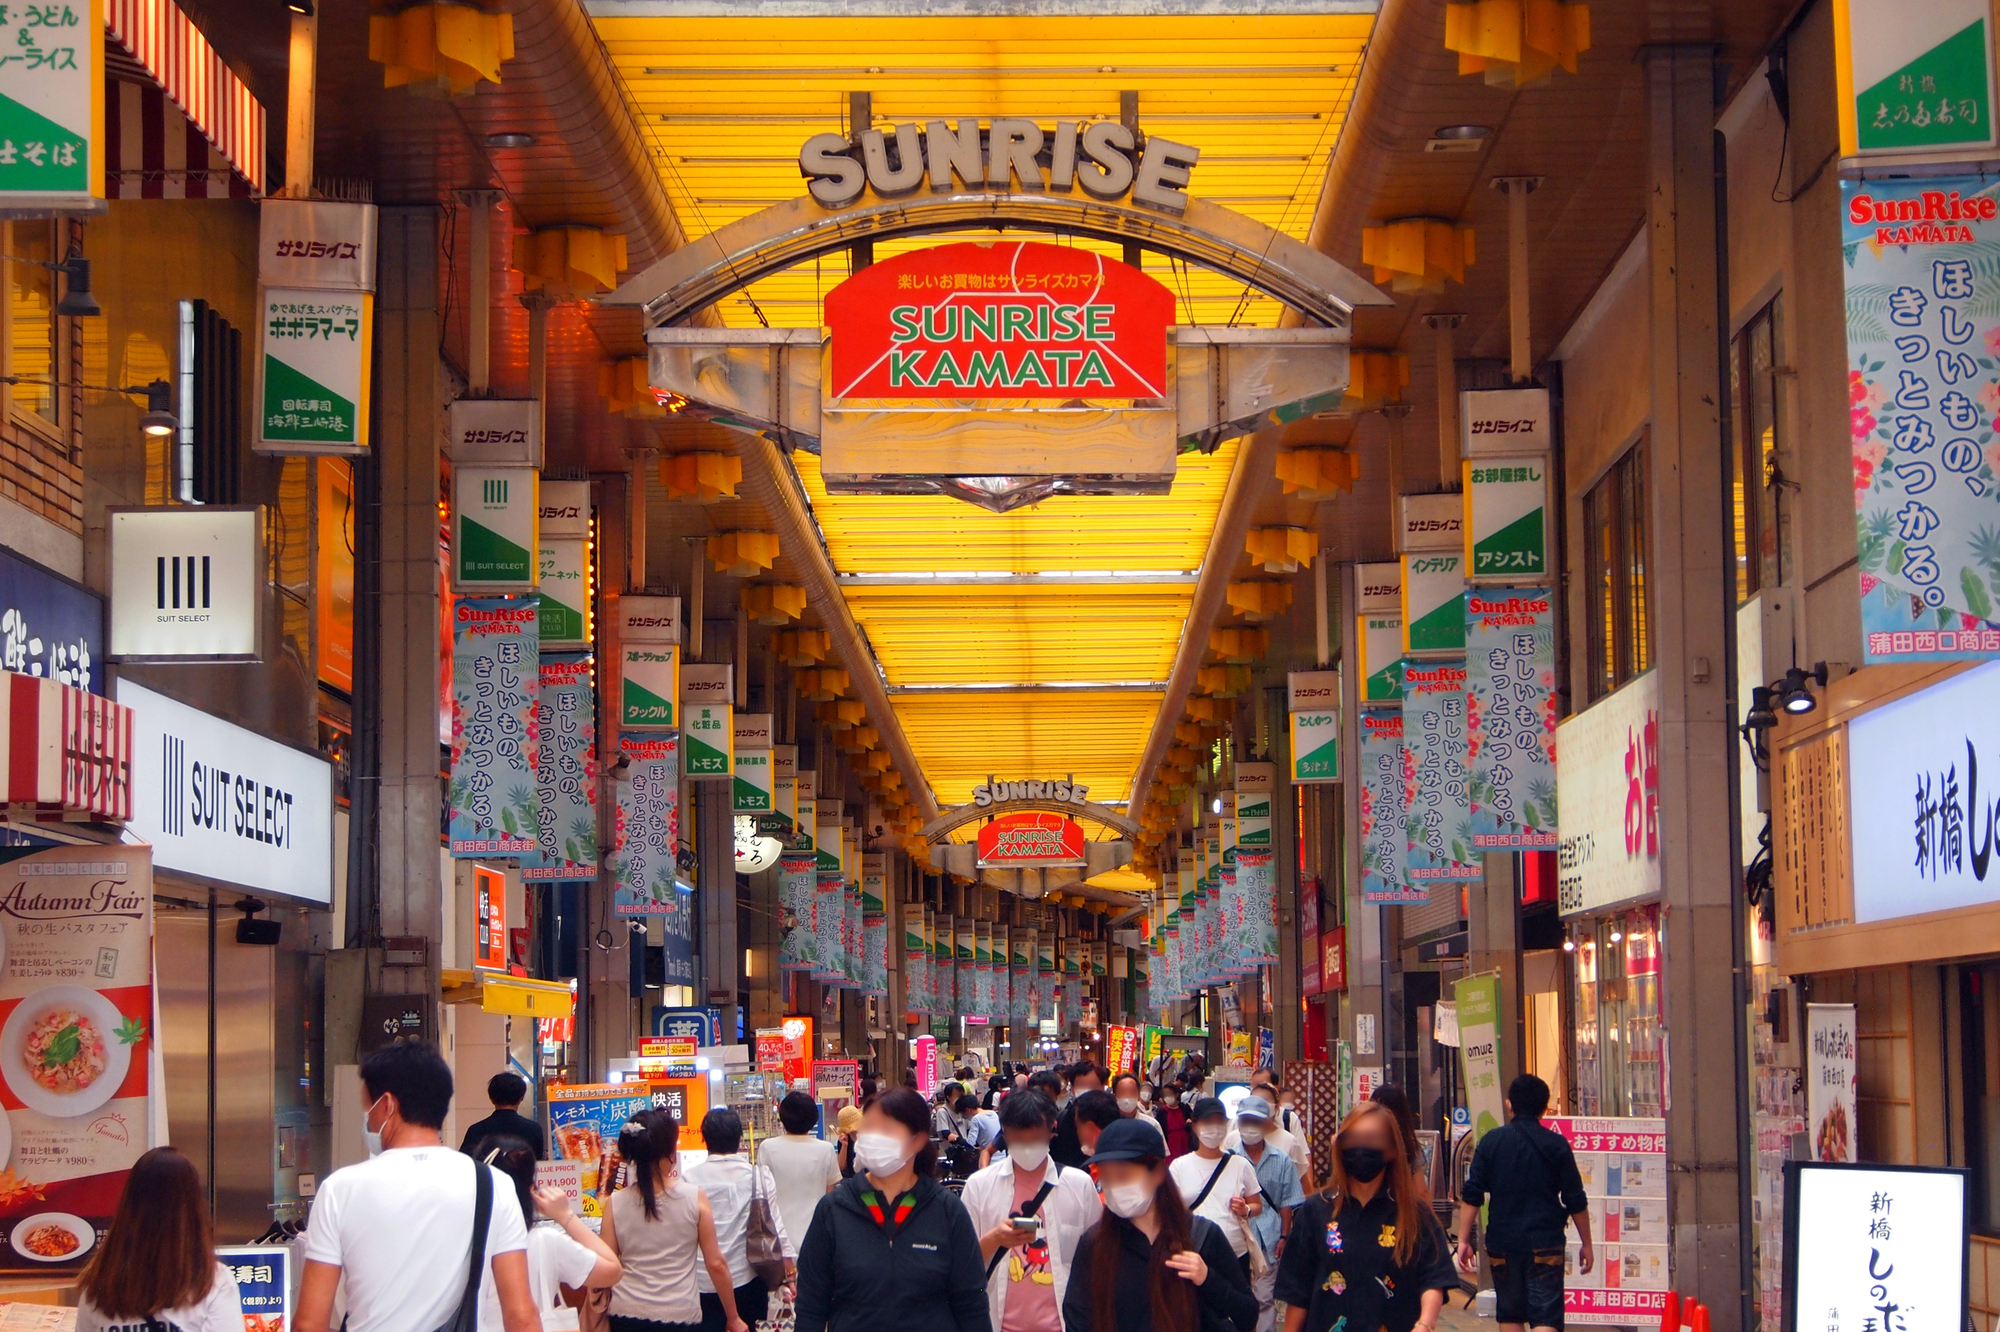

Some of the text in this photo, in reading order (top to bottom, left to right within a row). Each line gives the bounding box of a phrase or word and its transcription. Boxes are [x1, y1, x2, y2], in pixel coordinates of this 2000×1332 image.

[18, 28, 35, 46] &
[800, 118, 1200, 216] SUNRISE
[1849, 191, 1998, 225] SunRise
[1875, 225, 1976, 246] KAMATA
[276, 240, 361, 260] サンライズ
[898, 274, 1106, 289] 楽しいお買物はサンライズカマタ
[269, 303, 359, 316] ゆであげ生スパゲティ
[269, 318, 358, 341] ポポラマーマ
[890, 304, 1115, 343] SUNRISE
[890, 350, 1115, 387] KAMATA
[1932, 259, 1986, 497] ほしいもの、
[282, 400, 331, 413] 回転寿司
[268, 416, 349, 432] 海鮮三崎港
[1471, 420, 1537, 434] サンライズ
[463, 430, 528, 444] サンライズ
[1888, 286, 1945, 608] きっとみつかる。
[1471, 468, 1541, 483] お部屋探し
[1408, 519, 1462, 532] サンライズ
[477, 562, 525, 570] SUIT SELECT
[1412, 557, 1459, 574] インテリア
[1478, 551, 1540, 567] アシスト
[1469, 598, 1549, 614] SunRise
[156, 614, 211, 623] SUIT SELECT
[457, 606, 536, 622] SunRise
[1483, 615, 1536, 626] KAMATA
[470, 624, 522, 635] KAMATA
[627, 617, 674, 628] サンライズ
[626, 650, 673, 663] スポーツショップ
[688, 682, 727, 691] サンライズ
[1294, 688, 1332, 698] サンライズ
[1417, 683, 1462, 692] KAMATA
[1512, 634, 1538, 763] ほしいもの、
[496, 642, 520, 771] ほしいもの、
[628, 705, 668, 720] タックル
[702, 709, 711, 719] 薬
[692, 720, 721, 730] 化粧品
[1298, 715, 1332, 727] とんかつ
[735, 729, 769, 737] サンライズ
[1488, 648, 1515, 822] きっとみつかる。
[470, 655, 495, 829] きっとみつかる。
[556, 692, 580, 806] ほしいもの、
[620, 740, 676, 752] SunRise
[1442, 699, 1465, 807] ほしいもの、
[692, 757, 723, 770] トモズ
[538, 705, 559, 858] きっとみつかる。
[1421, 711, 1445, 859] きっとみつかる。
[973, 779, 1089, 807] SUNRISE
[191, 760, 293, 850] SUIT SELECT
[738, 797, 765, 807] トモズ
[647, 765, 668, 856] ほしいもの、
[1378, 753, 1397, 884] きっとみつかる。
[629, 775, 649, 897] きっとみつかる。
[998, 831, 1064, 843] SUNRISE
[1473, 833, 1557, 848] 蒲田西口商店街
[452, 839, 535, 854] 蒲田西口商店街
[998, 844, 1064, 856] KAMATA
[780, 860, 816, 868] SunRise
[1237, 853, 1273, 862] SunRise
[522, 868, 597, 879] 蒲田西口商店街
[1410, 867, 1482, 880] 蒲田西口商店街
[0, 880, 145, 913] Autumn Fair
[617, 904, 675, 915] 蒲田西口商店街
[17, 923, 128, 936] 秋の生パスタフェア
[10, 959, 93, 967] 舞茸と吊るしベーコンの
[100, 951, 114, 976] 和風
[10, 968, 77, 978] 生姜しょうゆ ¥830
[555, 1087, 635, 1099] 全品お持ち帰りできます
[651, 1092, 682, 1107] 快活
[554, 1100, 610, 1120] レモネード
[94, 1122, 126, 1143] Tomato
[20, 1146, 69, 1155] 舞茸と牡蠣の
[20, 1156, 87, 1166] アラビアータ ¥980
[556, 1164, 576, 1173] PRICE
[546, 1178, 577, 1187] ¥1,900
[1869, 1191, 1894, 1241] 新橋
